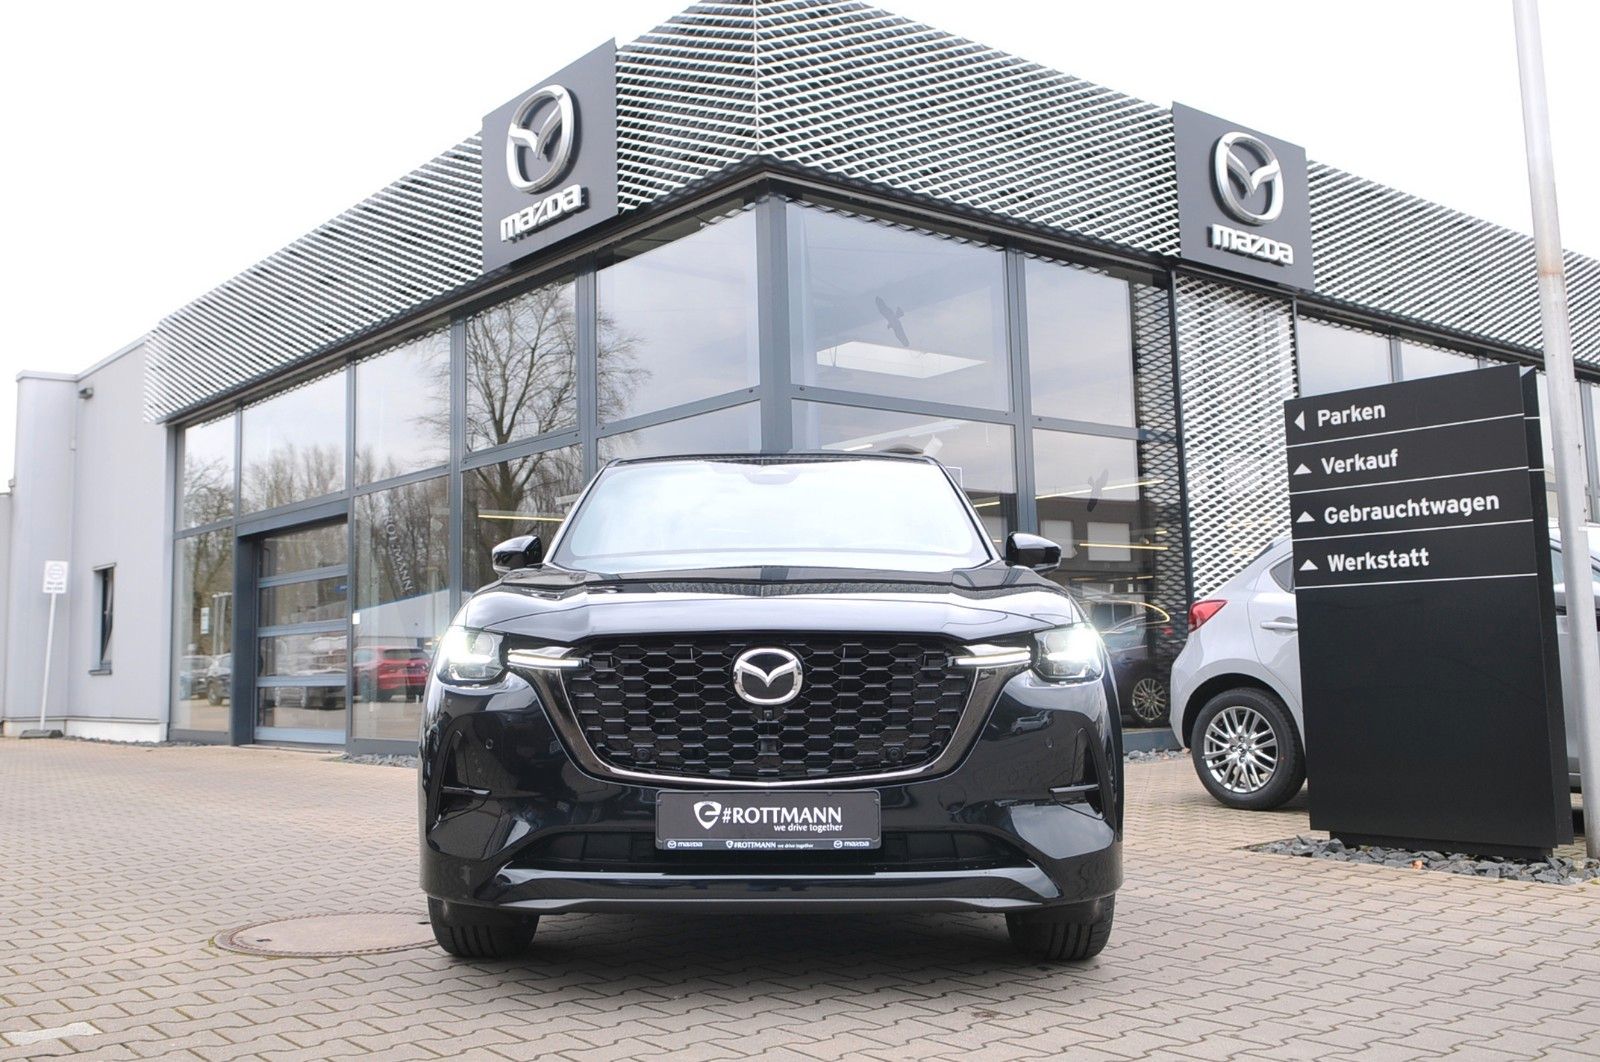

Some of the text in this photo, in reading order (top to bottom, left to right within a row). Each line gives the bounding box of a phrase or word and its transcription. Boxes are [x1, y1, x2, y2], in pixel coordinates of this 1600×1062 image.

[500, 184, 582, 242] mazda
[1211, 224, 1294, 265] mazda
[1317, 403, 1386, 427] Parken
[1321, 448, 1399, 475] Verkauf
[1324, 494, 1500, 525] Gebrauchtwagen
[1327, 547, 1430, 572] Werkstatt
[722, 807, 842, 824] #ROTTMANN
[788, 823, 807, 831] drive
[809, 823, 843, 834] together
